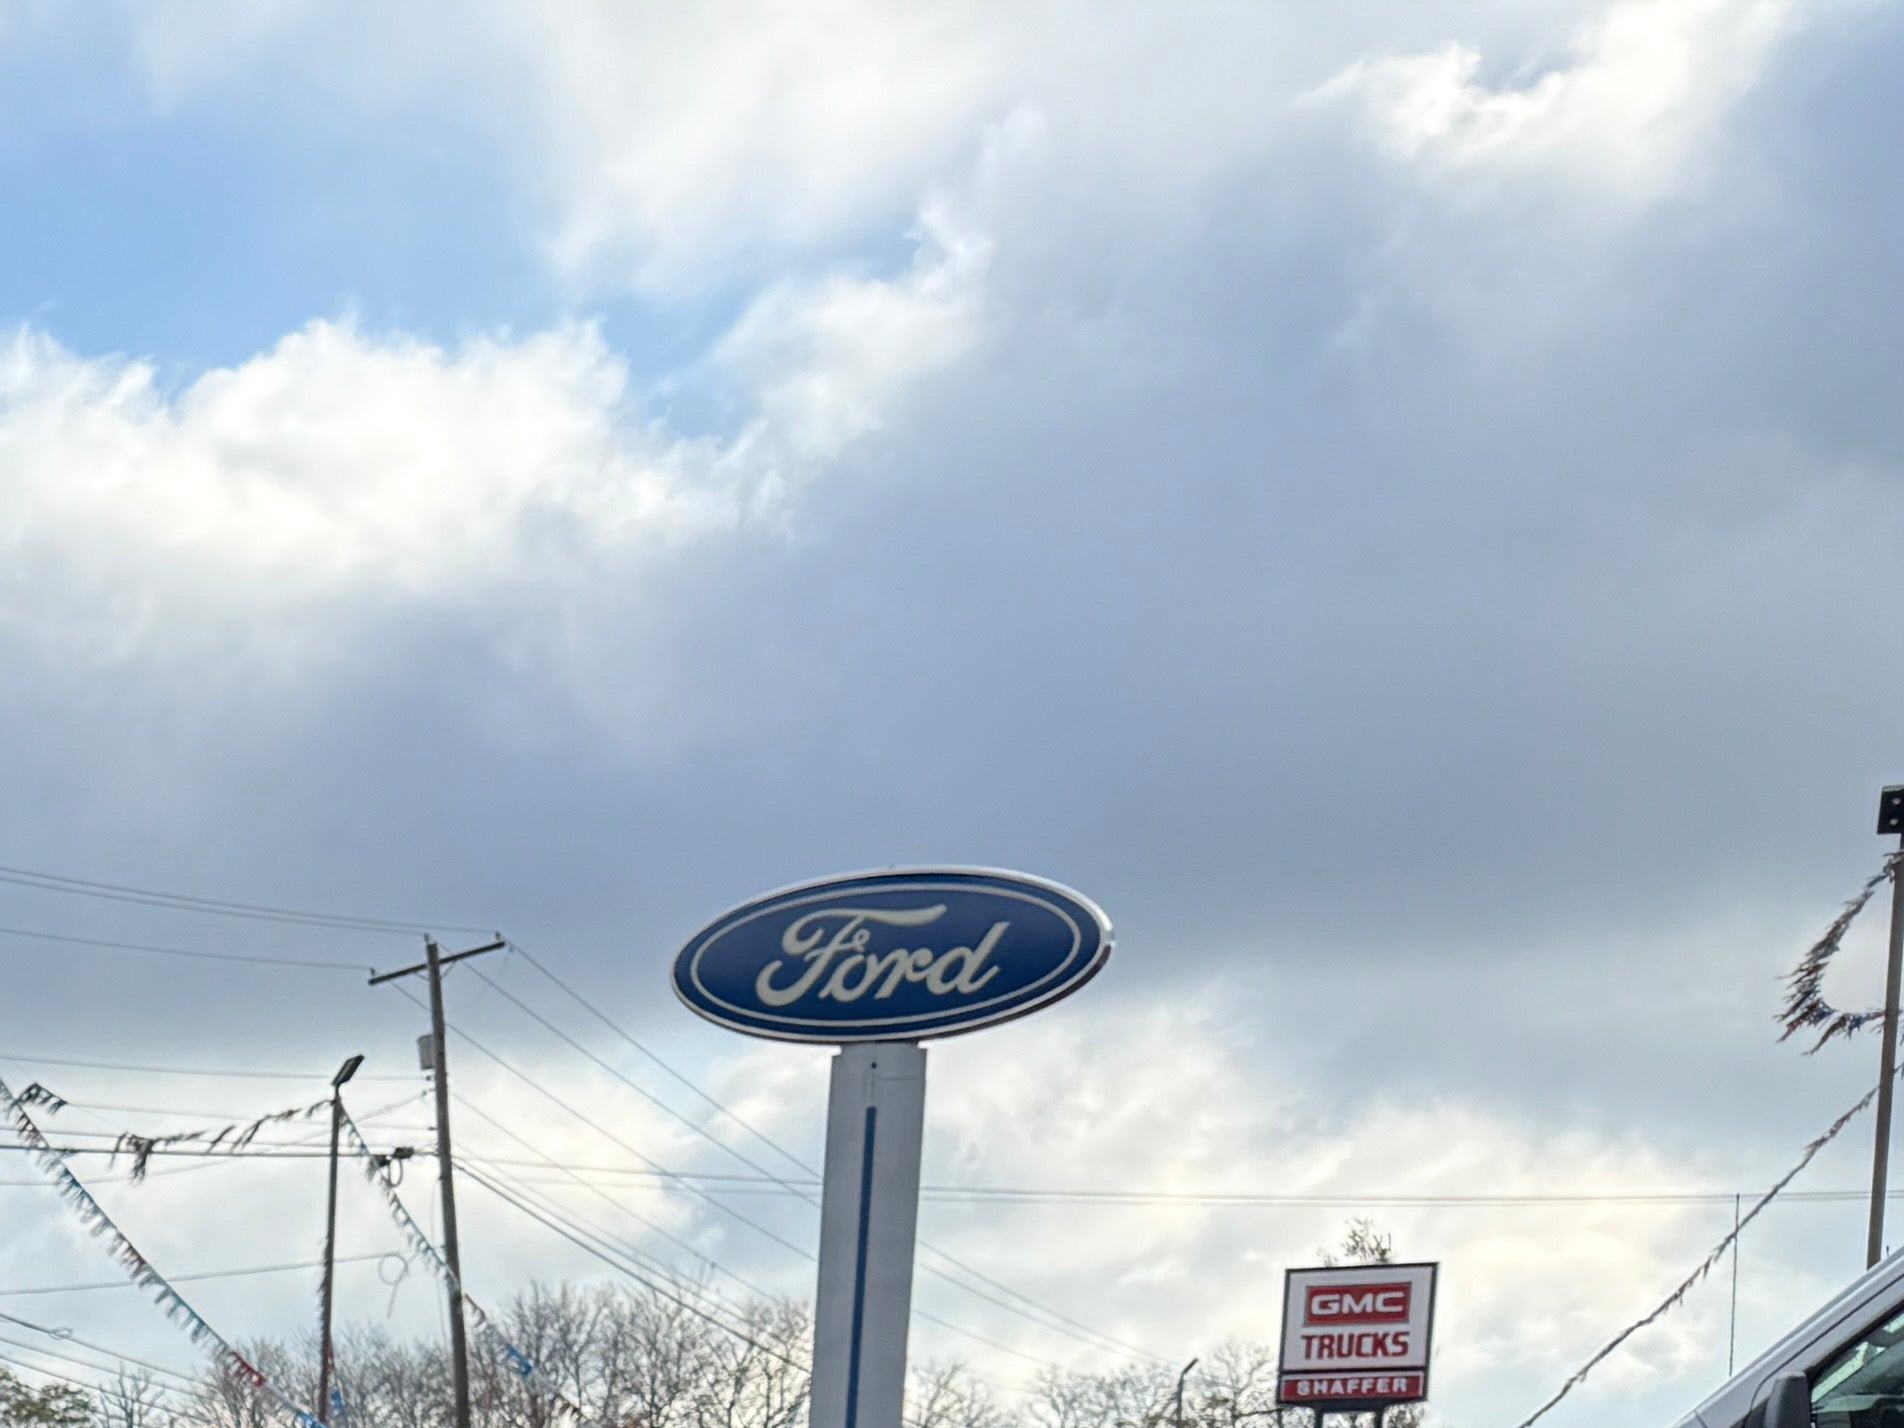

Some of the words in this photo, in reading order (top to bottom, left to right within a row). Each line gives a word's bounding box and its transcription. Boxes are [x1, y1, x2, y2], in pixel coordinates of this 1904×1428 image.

[755, 903, 1010, 1006] Ford
[1311, 1291, 1405, 1316] GMC
[1301, 1331, 1410, 1360] TRUCKS
[1296, 1377, 1408, 1396] SHAFFER
